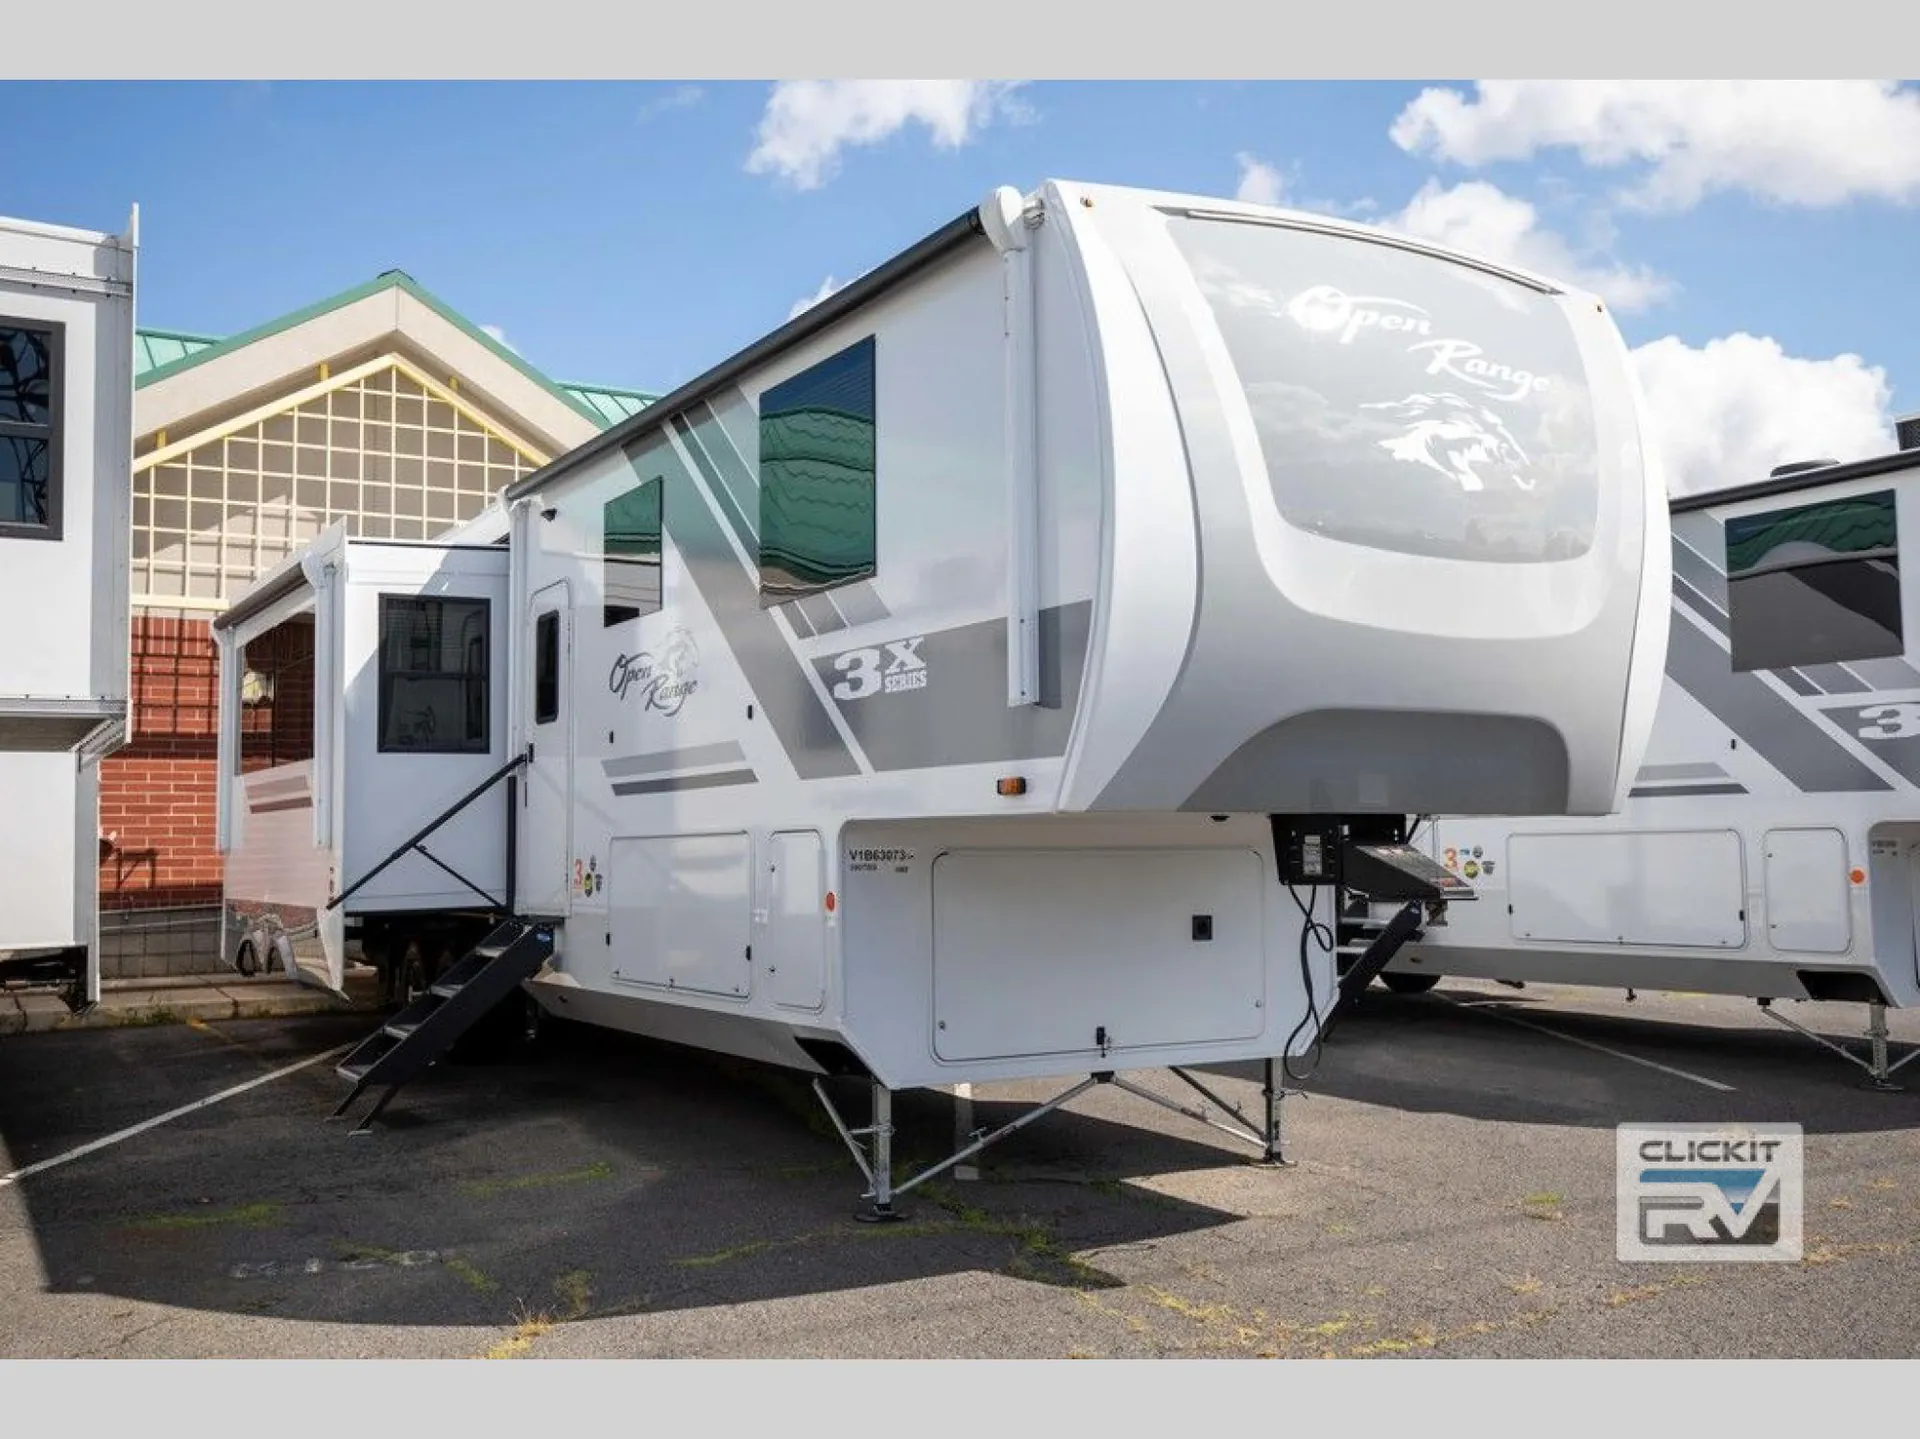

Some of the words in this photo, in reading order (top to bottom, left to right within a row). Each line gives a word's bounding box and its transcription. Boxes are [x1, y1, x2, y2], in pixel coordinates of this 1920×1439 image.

[1288, 285, 1432, 343] Open
[1407, 338, 1550, 400] Range
[609, 653, 654, 701] Open
[641, 673, 698, 717] Range
[884, 670, 927, 693] SERIES
